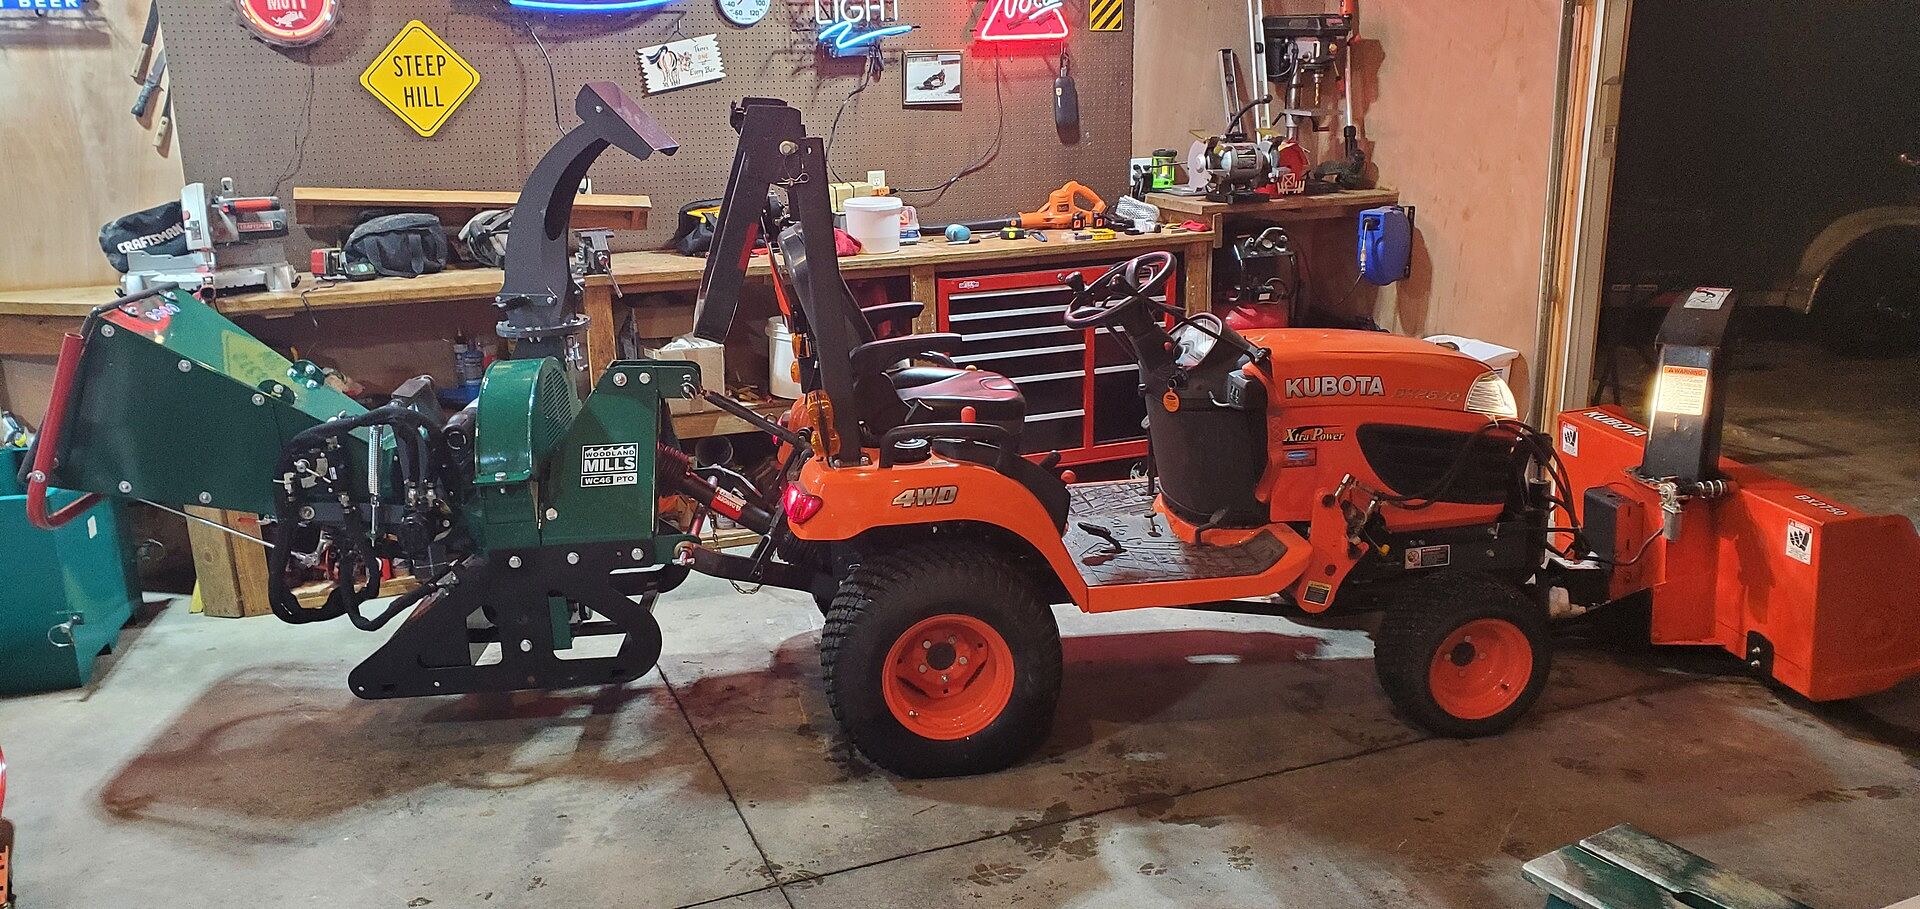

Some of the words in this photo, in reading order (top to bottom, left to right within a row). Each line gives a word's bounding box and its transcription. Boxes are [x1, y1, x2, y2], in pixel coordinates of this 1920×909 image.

[393, 55, 446, 77] STEEP
[404, 86, 445, 107] HILL
[117, 224, 185, 253] CRAFTSMAN
[1285, 376, 1385, 398] KUBOTA
[1283, 428, 1310, 442] Xtra
[1310, 427, 1345, 441] Power
[1583, 411, 1647, 437] KUBOTA
[584, 457, 635, 472] MILLS
[586, 450, 635, 458] WOODLAND
[585, 477, 612, 485] WC46
[616, 475, 635, 483] PTO
[891, 485, 958, 508] 4WD
